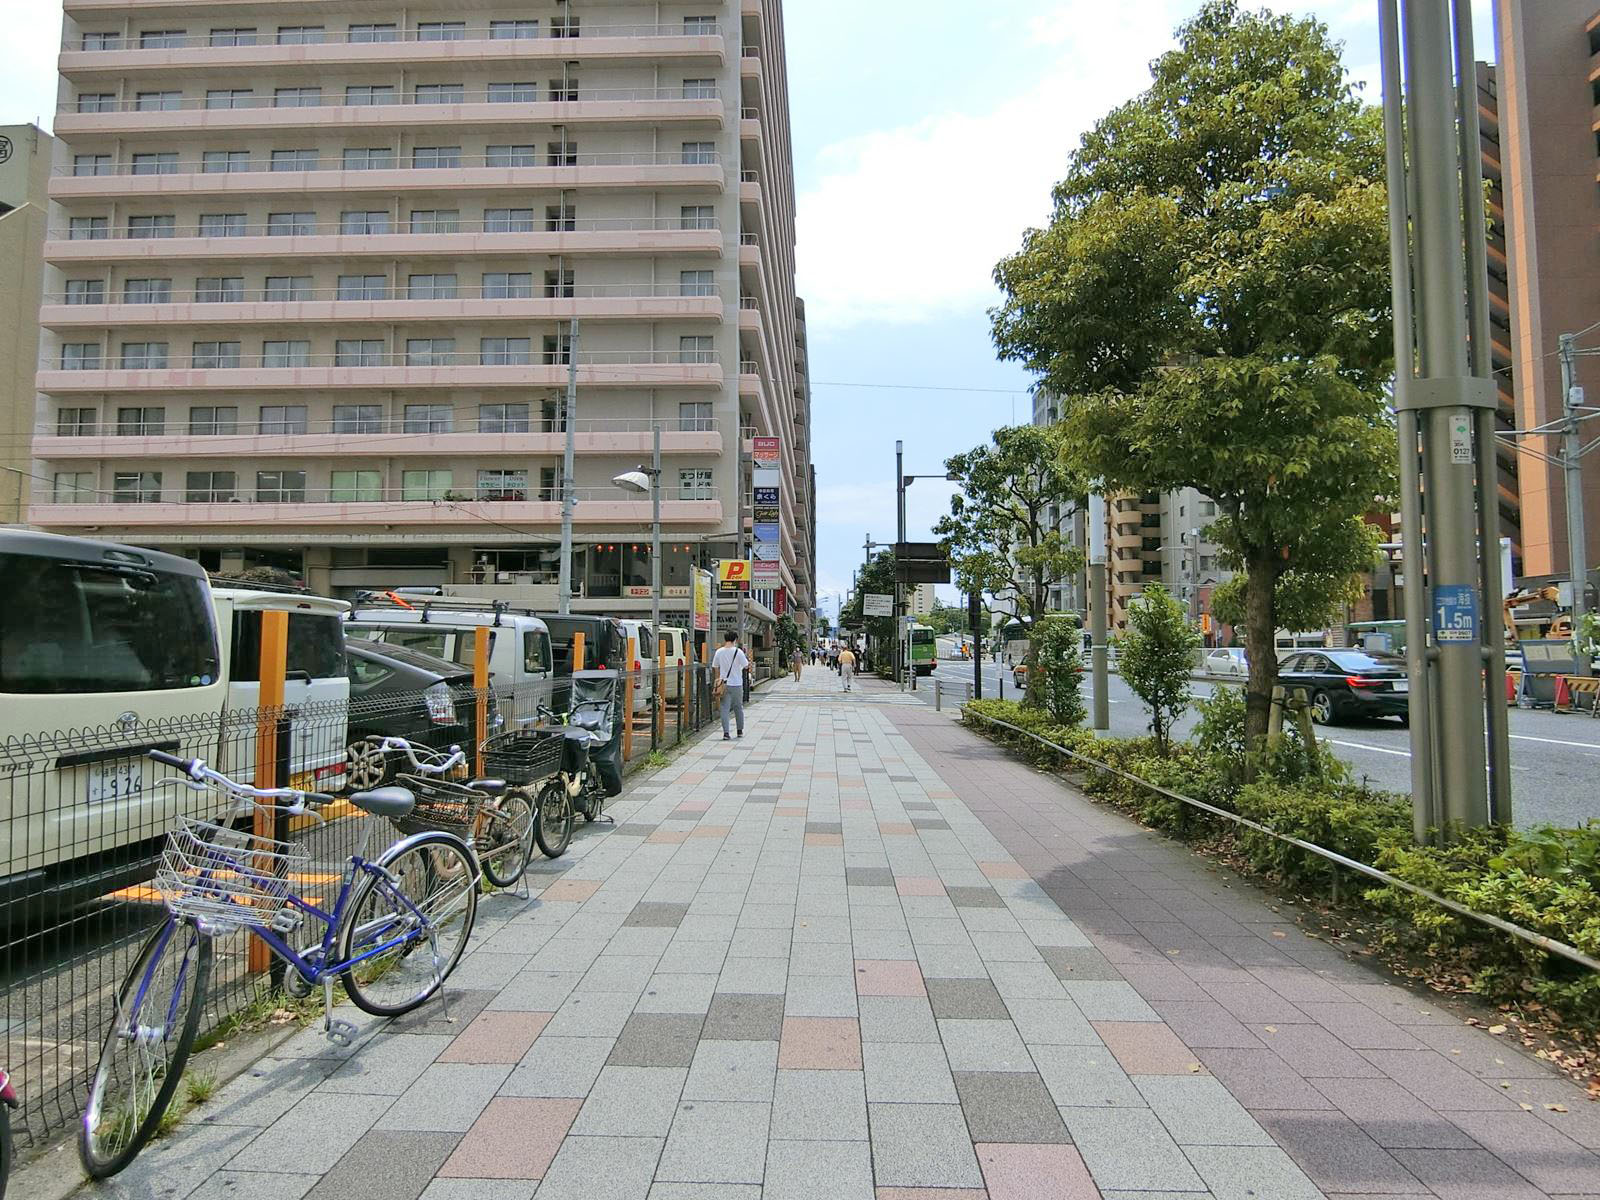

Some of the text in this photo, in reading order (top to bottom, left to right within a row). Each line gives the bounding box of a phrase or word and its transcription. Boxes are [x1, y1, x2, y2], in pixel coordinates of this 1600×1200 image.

[680, 471, 712, 480] まつげ屋
[726, 562, 745, 580] P
[1437, 606, 1472, 629] 1.5m
